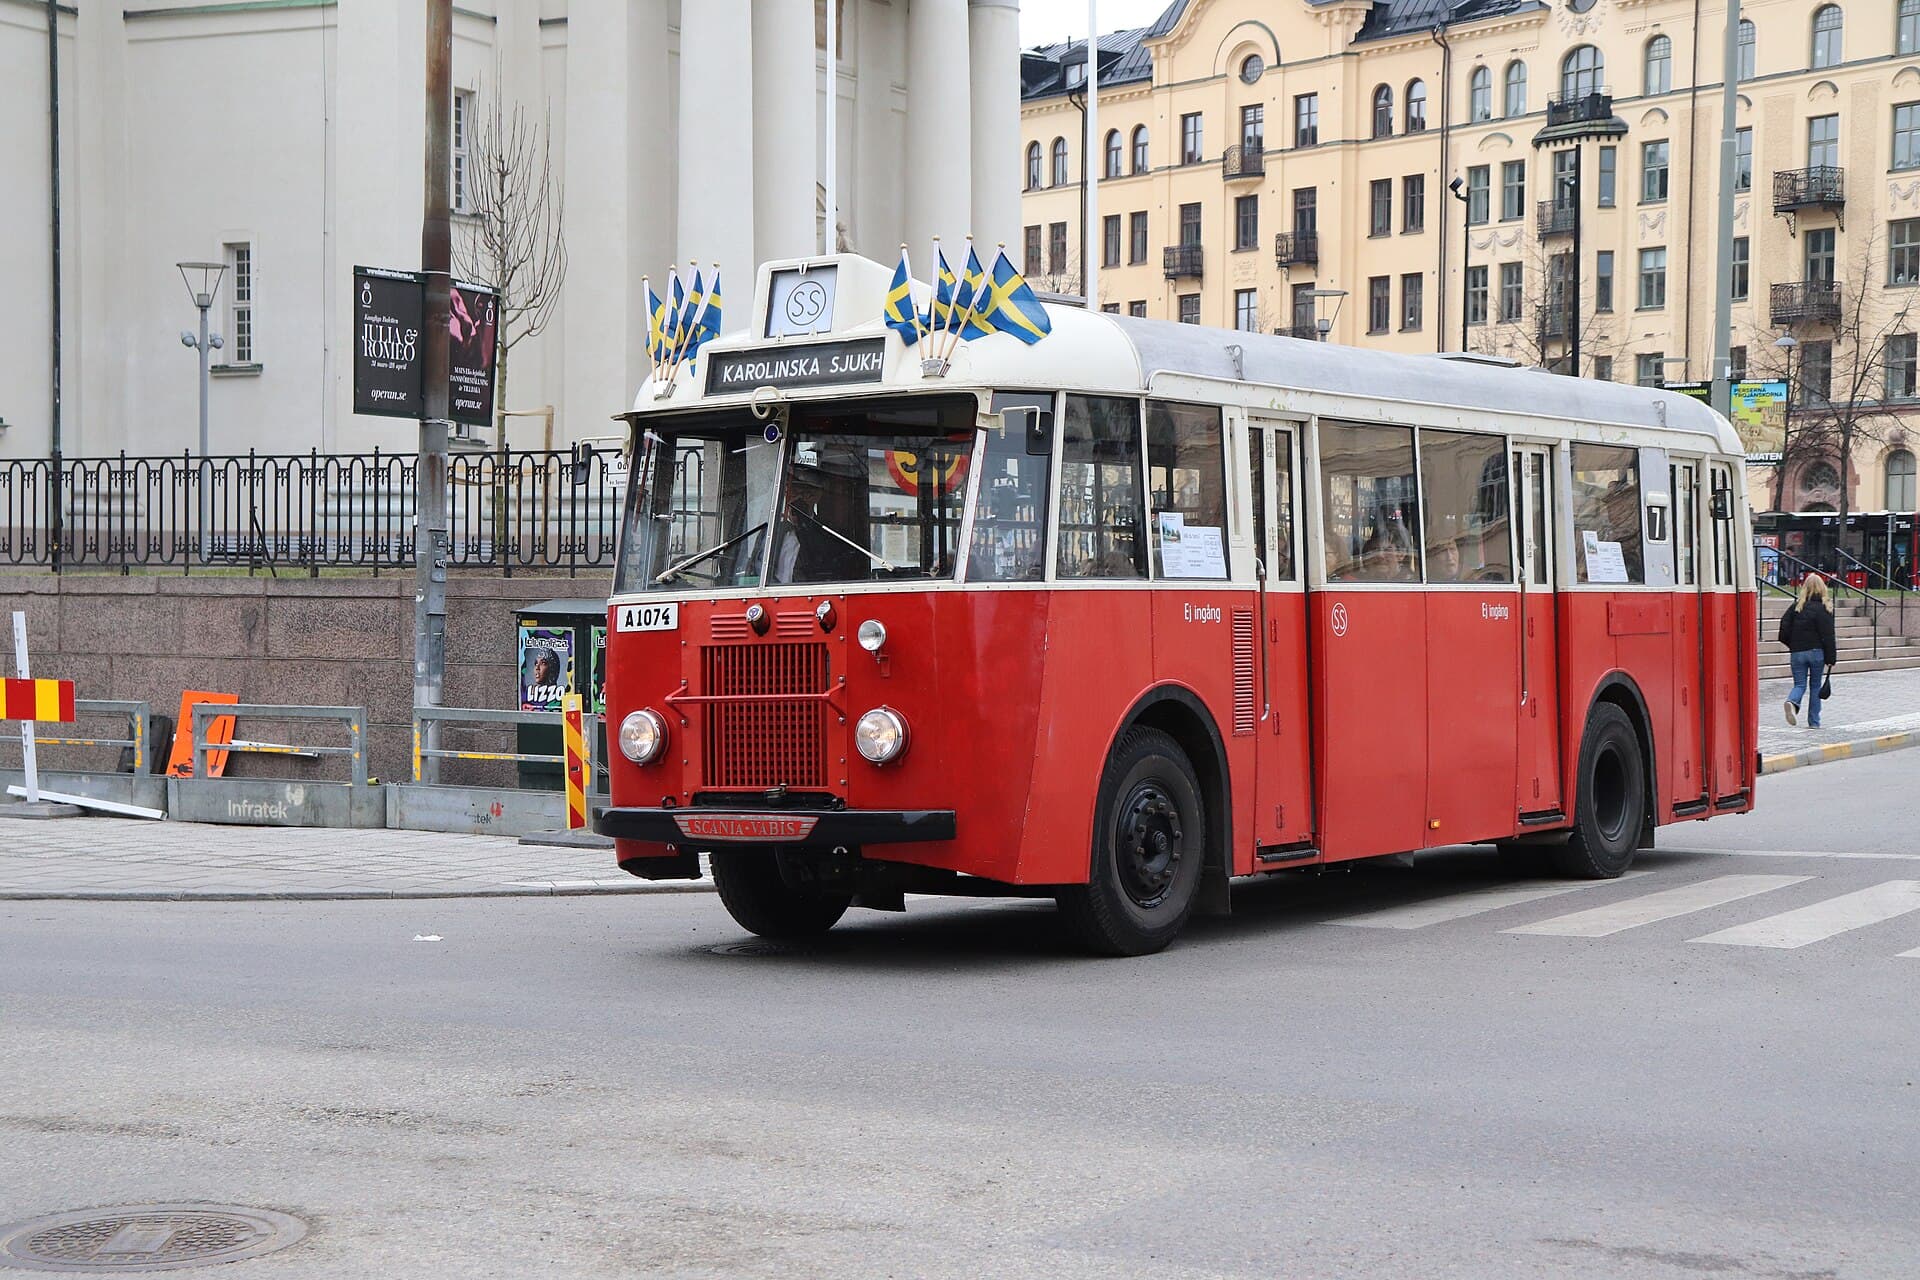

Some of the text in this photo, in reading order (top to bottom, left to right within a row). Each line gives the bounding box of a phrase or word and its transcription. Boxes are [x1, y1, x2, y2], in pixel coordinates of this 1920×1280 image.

[361, 323, 419, 346] JULIA &
[361, 339, 416, 362] ROMEO
[722, 351, 883, 383] KAROLINSKA SJUKH
[371, 389, 407, 401] operan.se
[455, 398, 483, 411] operan.se
[1651, 507, 1661, 539] 7
[1184, 603, 1221, 624] Ej ingång
[1489, 603, 1509, 620] ingång
[527, 684, 566, 703] LIZZO
[227, 799, 288, 819] Infratek
